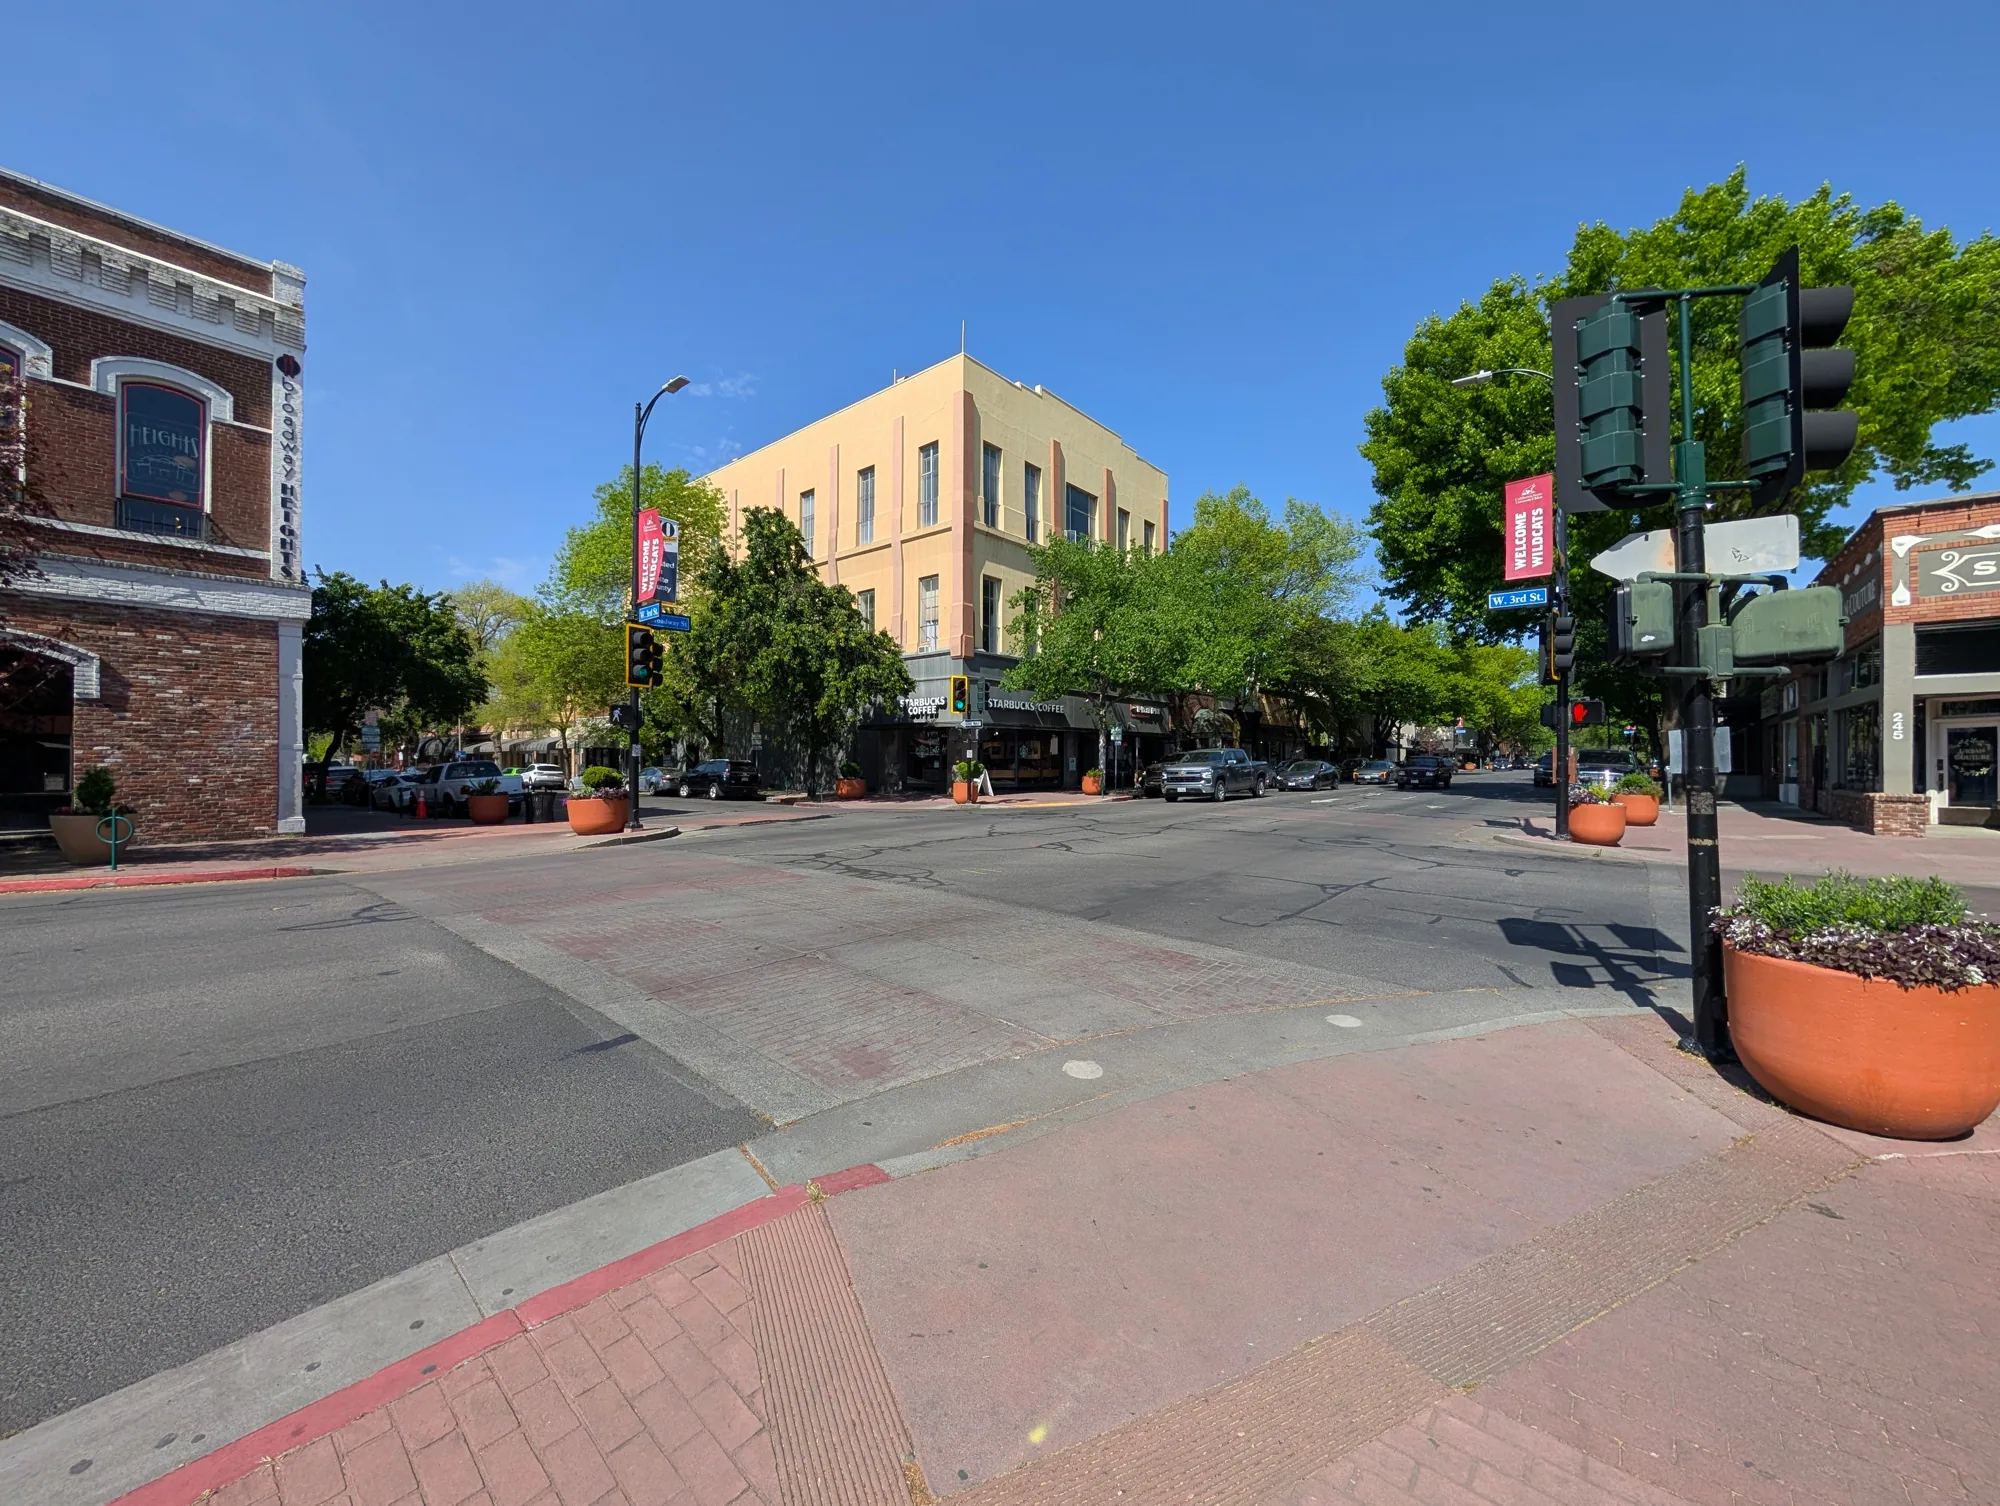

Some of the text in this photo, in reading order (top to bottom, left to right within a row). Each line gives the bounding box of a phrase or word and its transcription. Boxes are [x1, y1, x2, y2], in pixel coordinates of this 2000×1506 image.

[130, 423, 199, 458] HEIGHTS
[279, 376, 296, 578] broadway HEIGHTS
[1515, 511, 1527, 571] WELCOME
[1532, 507, 1544, 568] WILDCATS
[641, 539, 651, 594] WELCOME
[648, 537, 660, 592] WILDCATS
[1492, 592, 1544, 606] W. 3rd St.
[653, 618, 680, 627] roadway
[900, 697, 945, 708] STARBUCKS
[908, 706, 937, 715] COFFEE
[988, 698, 1065, 714] STARBUCKS COFFEE
[1892, 712, 1904, 740] 245
